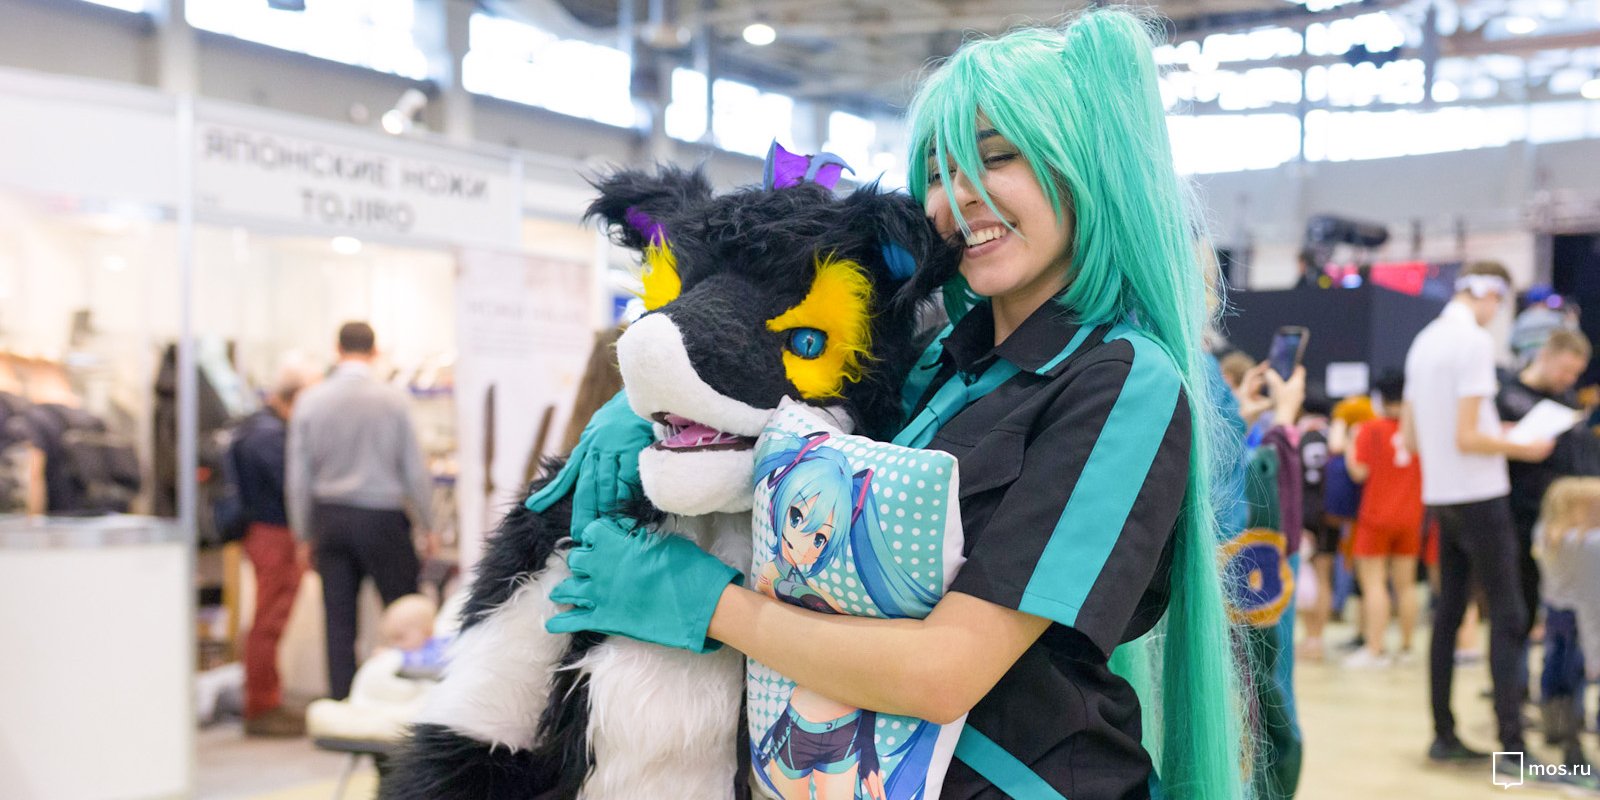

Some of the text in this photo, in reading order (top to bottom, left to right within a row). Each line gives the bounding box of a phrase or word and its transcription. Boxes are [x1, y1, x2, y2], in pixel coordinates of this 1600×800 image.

[204, 129, 489, 198] ЯПОНСКИЕ НОЖИ
[300, 188, 415, 231] TOJIRO
